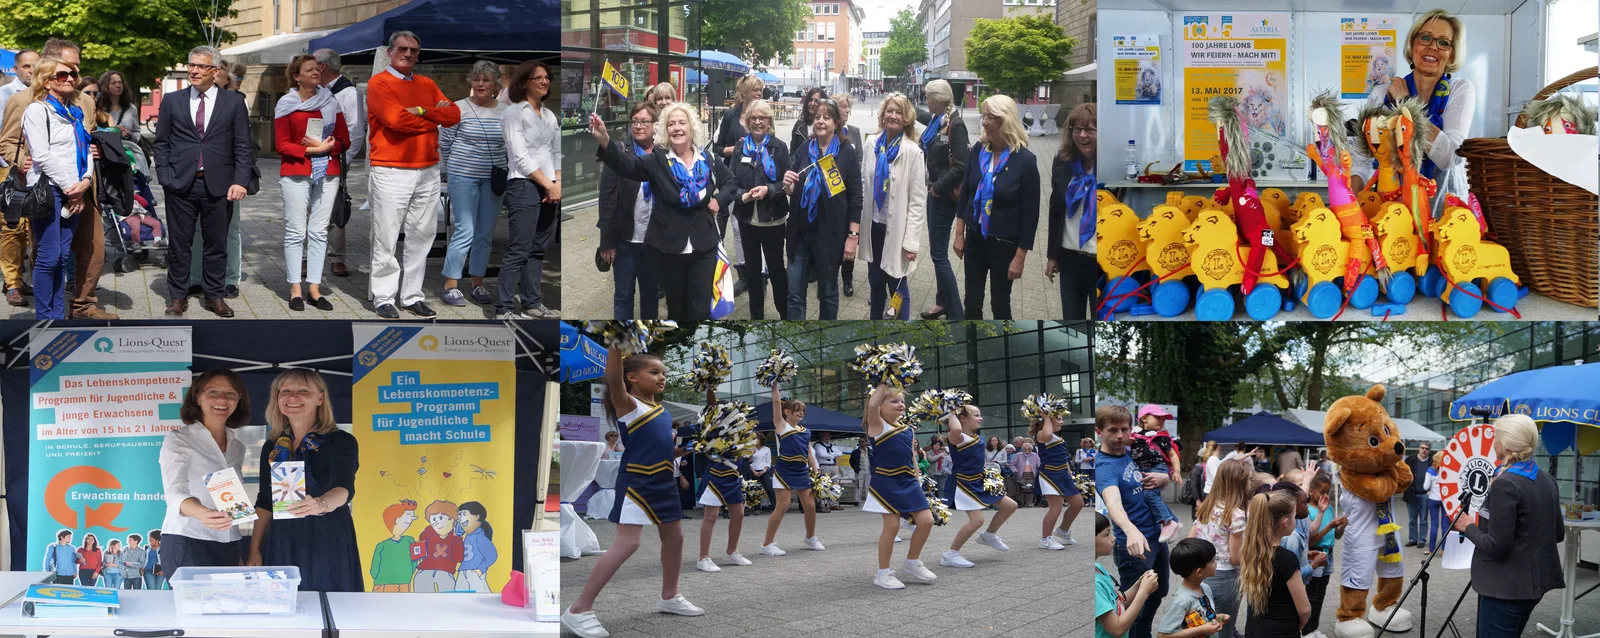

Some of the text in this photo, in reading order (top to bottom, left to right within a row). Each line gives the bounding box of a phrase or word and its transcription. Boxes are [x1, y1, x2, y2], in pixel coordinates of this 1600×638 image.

[612, 70, 625, 88] 100
[827, 164, 842, 186] 100
[119, 337, 185, 349] Lions-Quest
[444, 336, 511, 347] Lions-Quest
[65, 376, 185, 388] Das Lebenskompetenz-
[396, 375, 415, 385] Ein
[39, 392, 176, 406] Programm für Jugendliche &
[383, 388, 494, 399] Lebenskompetenz-
[416, 402, 475, 413] Programm
[1537, 407, 1578, 418] LIONS
[62, 409, 154, 421] junge Erwachsene
[377, 415, 468, 428] für Jugendliche
[56, 427, 78, 436] Alter
[118, 425, 131, 433] bis
[405, 429, 486, 441] macht Schule
[1470, 460, 1492, 476] LIONS
[1473, 472, 1483, 492] L
[71, 492, 130, 500] Erwachsen
